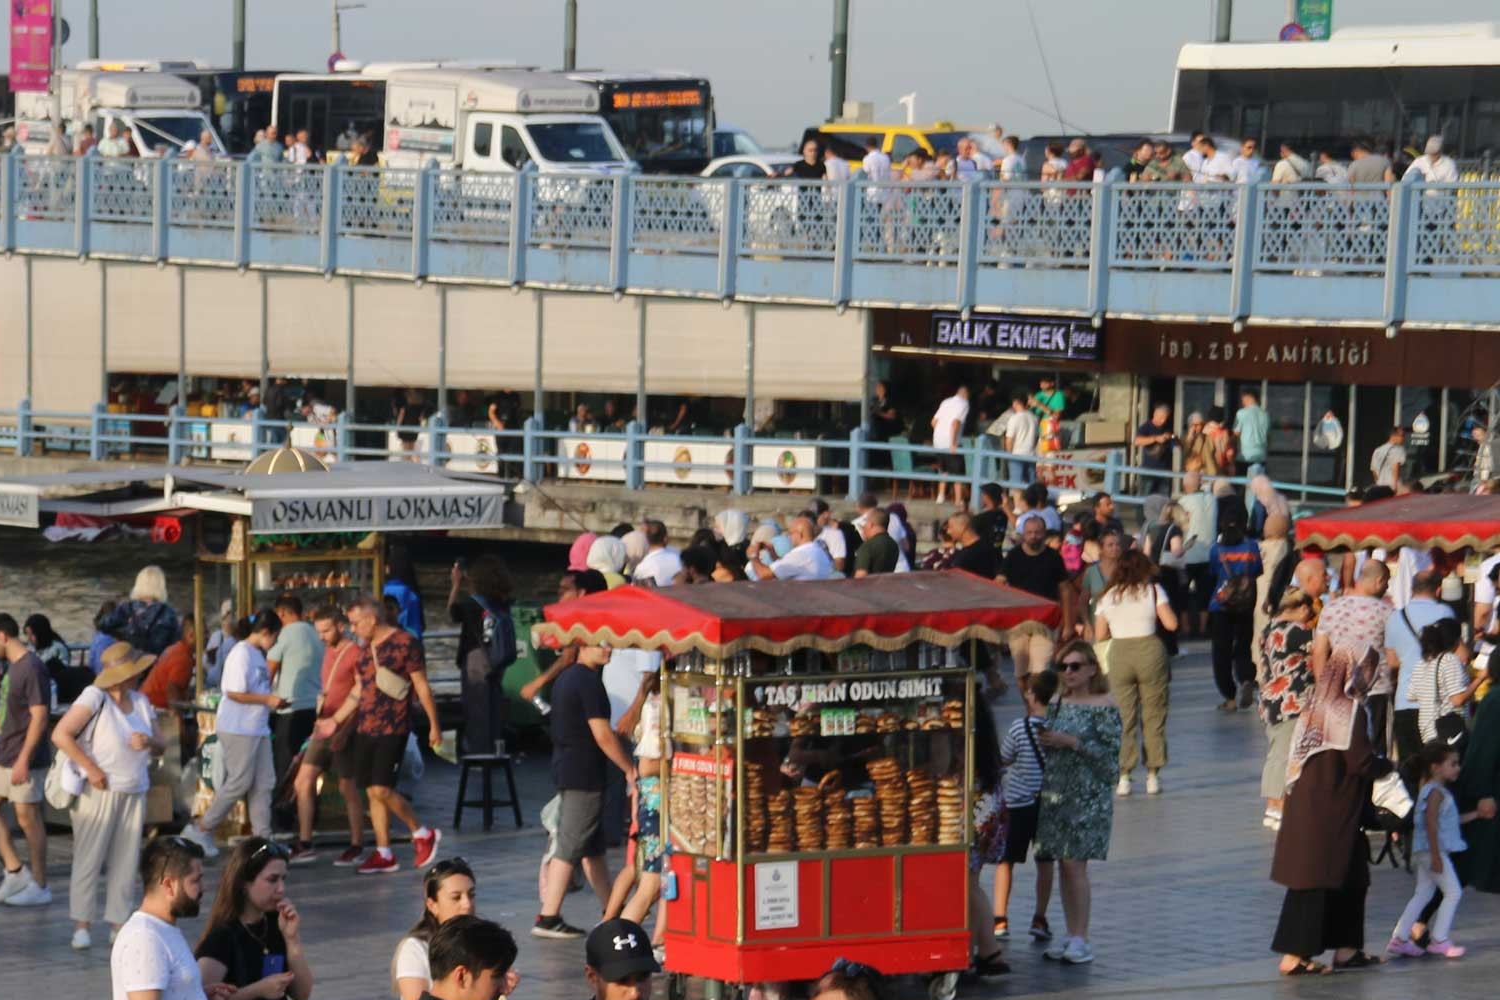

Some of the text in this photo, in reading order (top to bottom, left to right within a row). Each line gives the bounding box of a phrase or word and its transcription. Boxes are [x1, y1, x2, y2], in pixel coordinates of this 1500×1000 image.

[936, 319, 992, 347] BALIK
[996, 322, 1066, 351] EKMEK
[1266, 337, 1369, 365] AMİRLİĞİ
[272, 497, 483, 523] OSMANLI LOKMASI
[849, 681, 897, 701] ODUN
